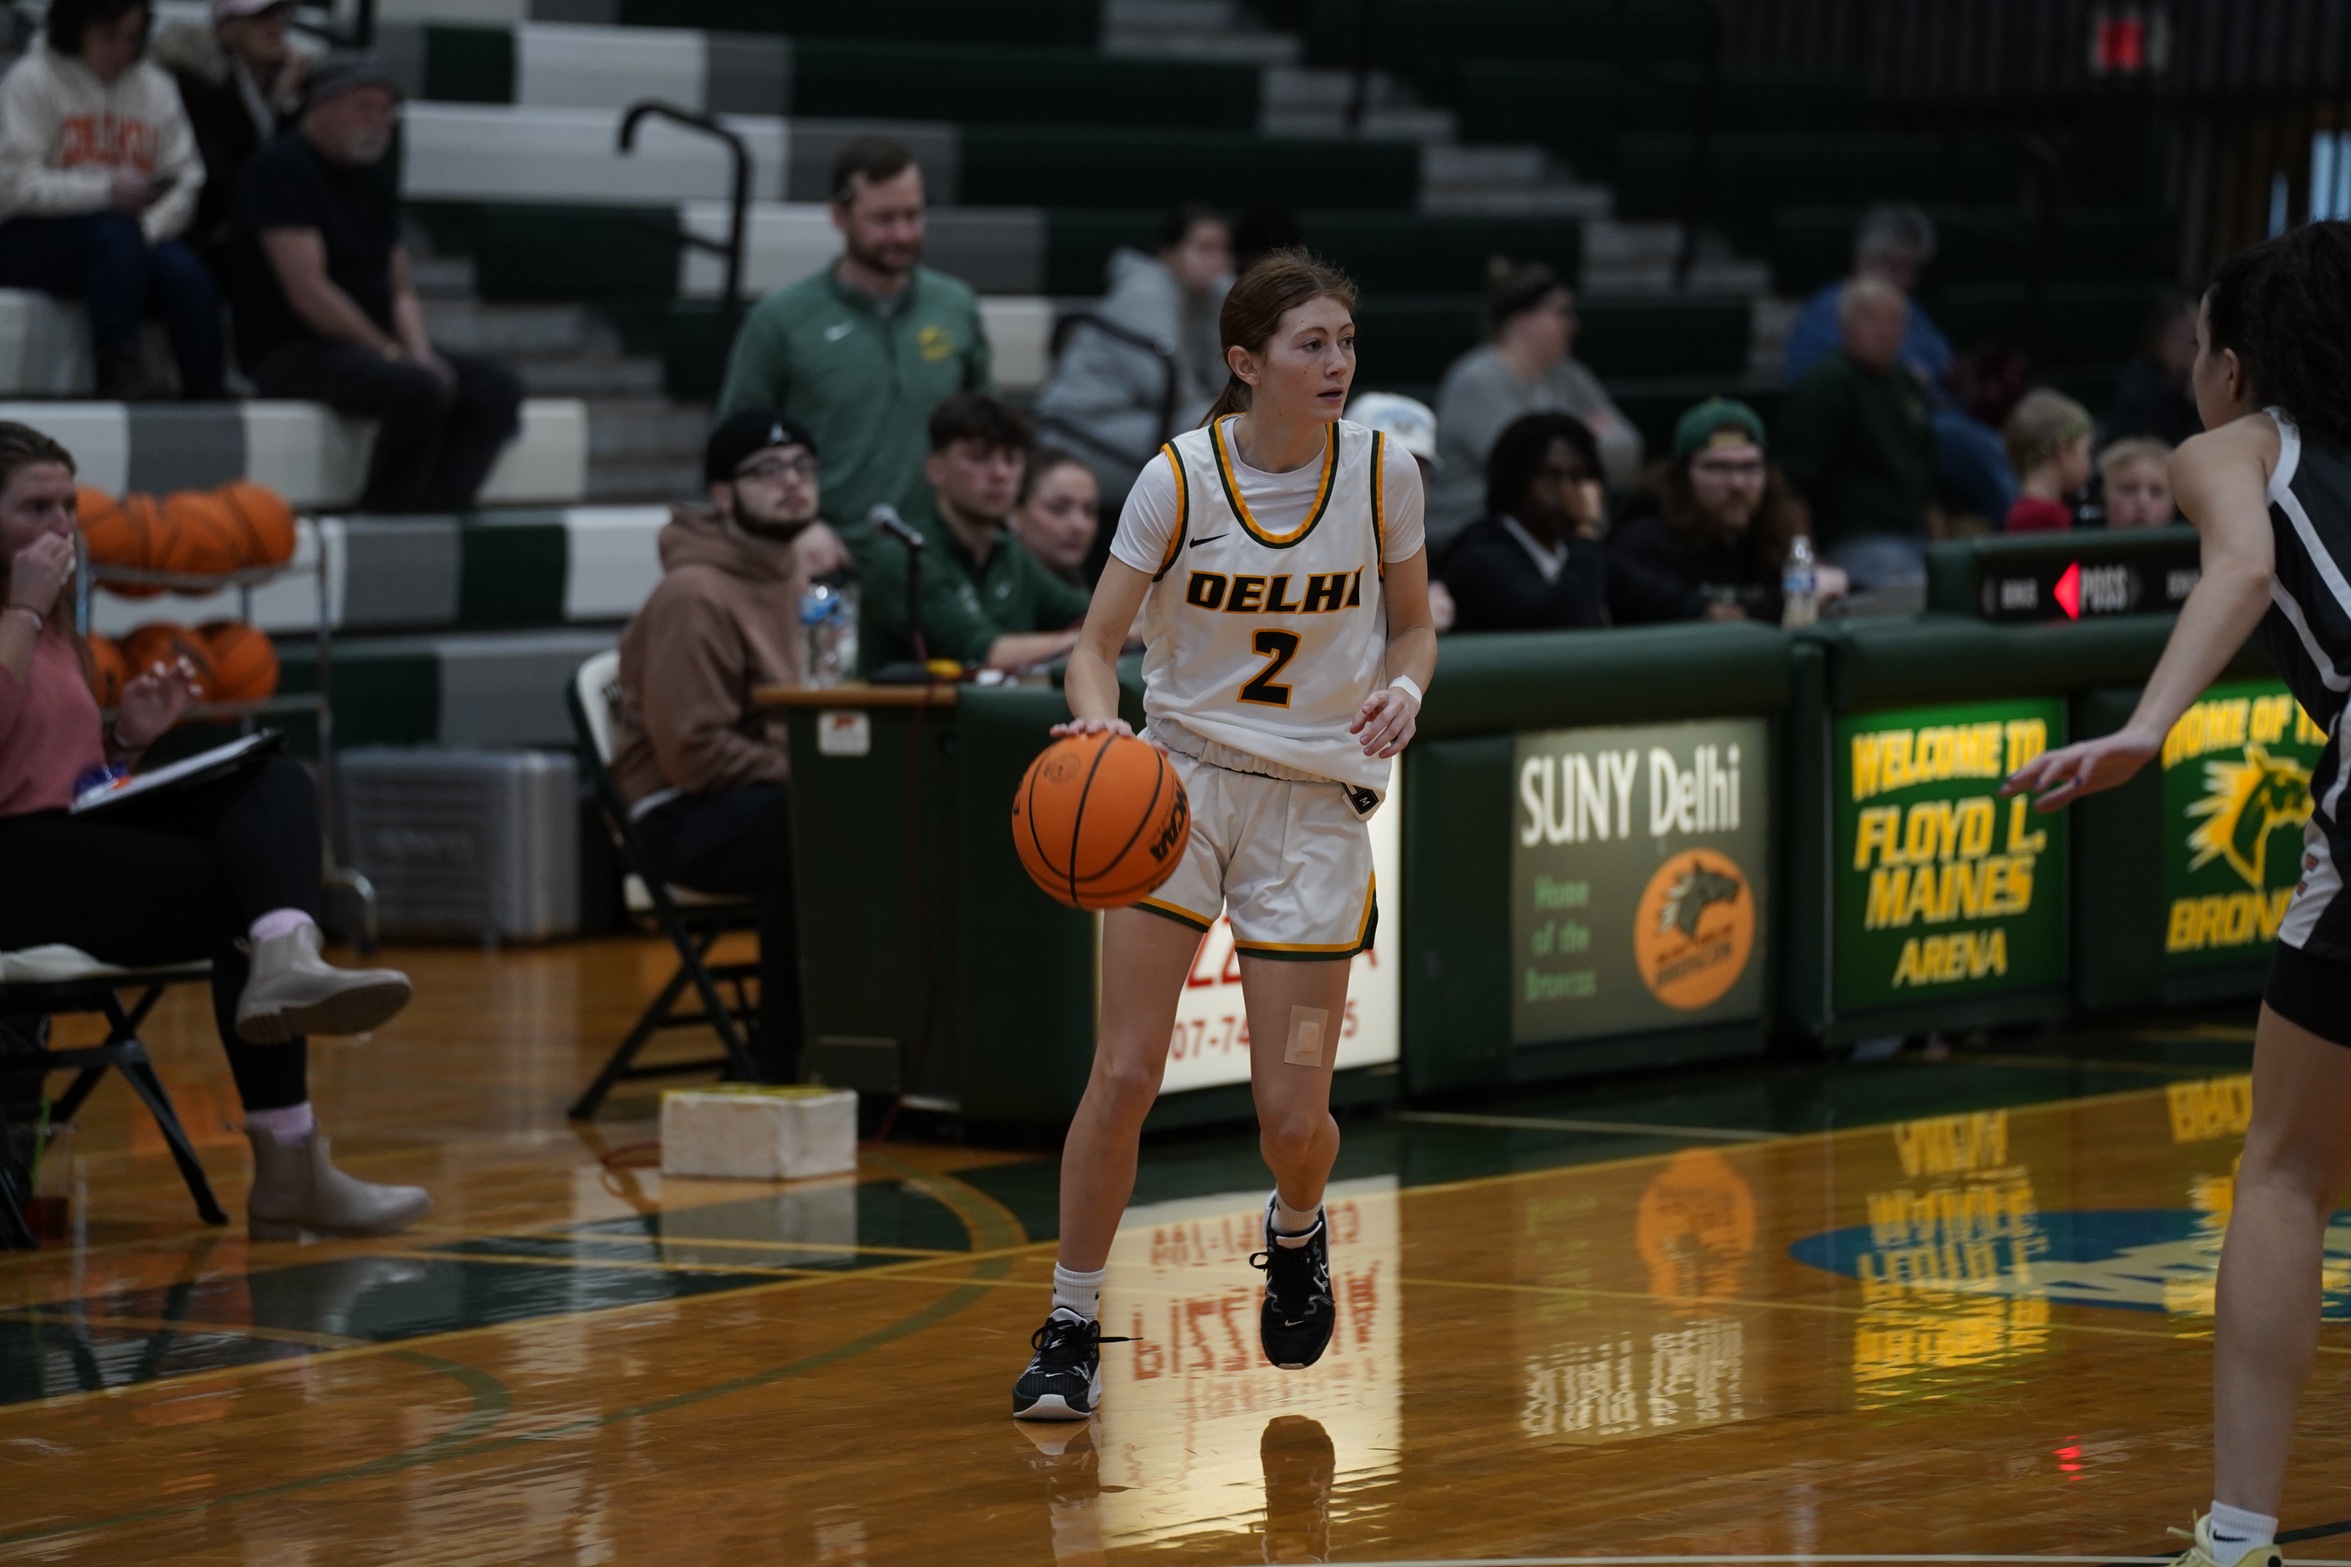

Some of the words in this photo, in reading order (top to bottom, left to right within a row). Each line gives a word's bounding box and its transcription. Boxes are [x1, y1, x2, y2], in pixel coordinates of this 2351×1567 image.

[1185, 565, 1366, 615] DELHI
[1236, 628, 1302, 709] 2
[2250, 693, 2294, 746] OF
[1520, 748, 1638, 848] SUNY
[1649, 741, 1741, 837] Delhi
[1852, 720, 2003, 801] WELCOME
[1854, 796, 1995, 871] FLOYD
[1865, 854, 2035, 931] MAINES
[2165, 886, 2296, 953] BRON
[1892, 927, 2008, 989] ARENA
